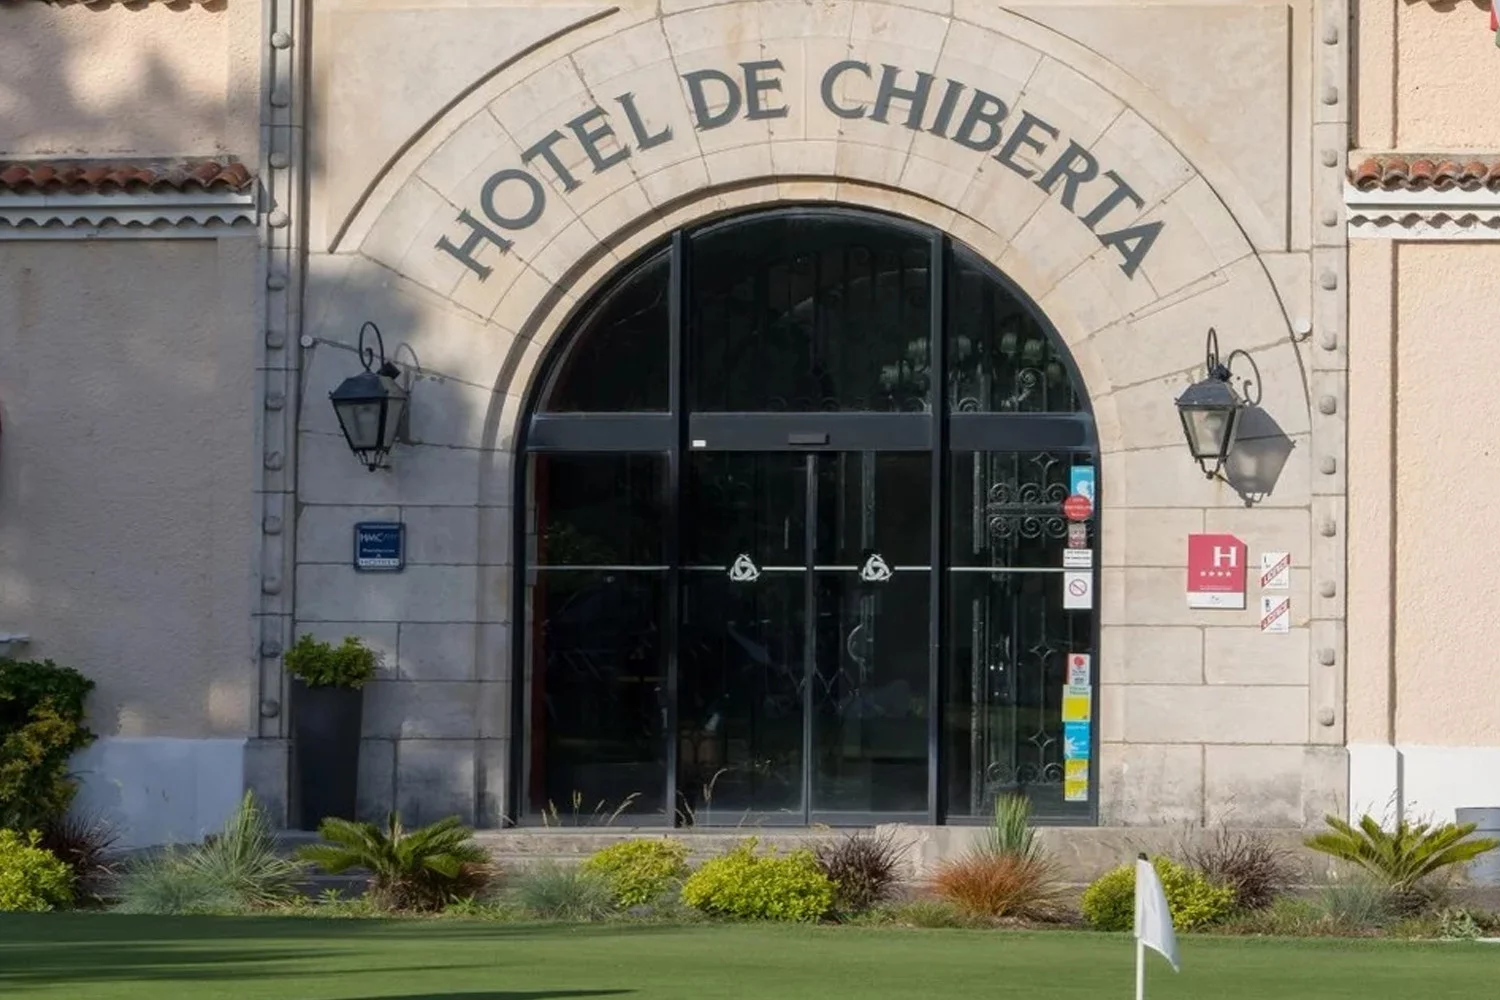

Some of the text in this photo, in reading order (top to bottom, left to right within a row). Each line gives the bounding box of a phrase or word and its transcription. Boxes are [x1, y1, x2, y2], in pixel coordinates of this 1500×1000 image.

[436, 59, 1164, 280] HOTEL DE CHIBERTA
[1213, 546, 1238, 567] H
